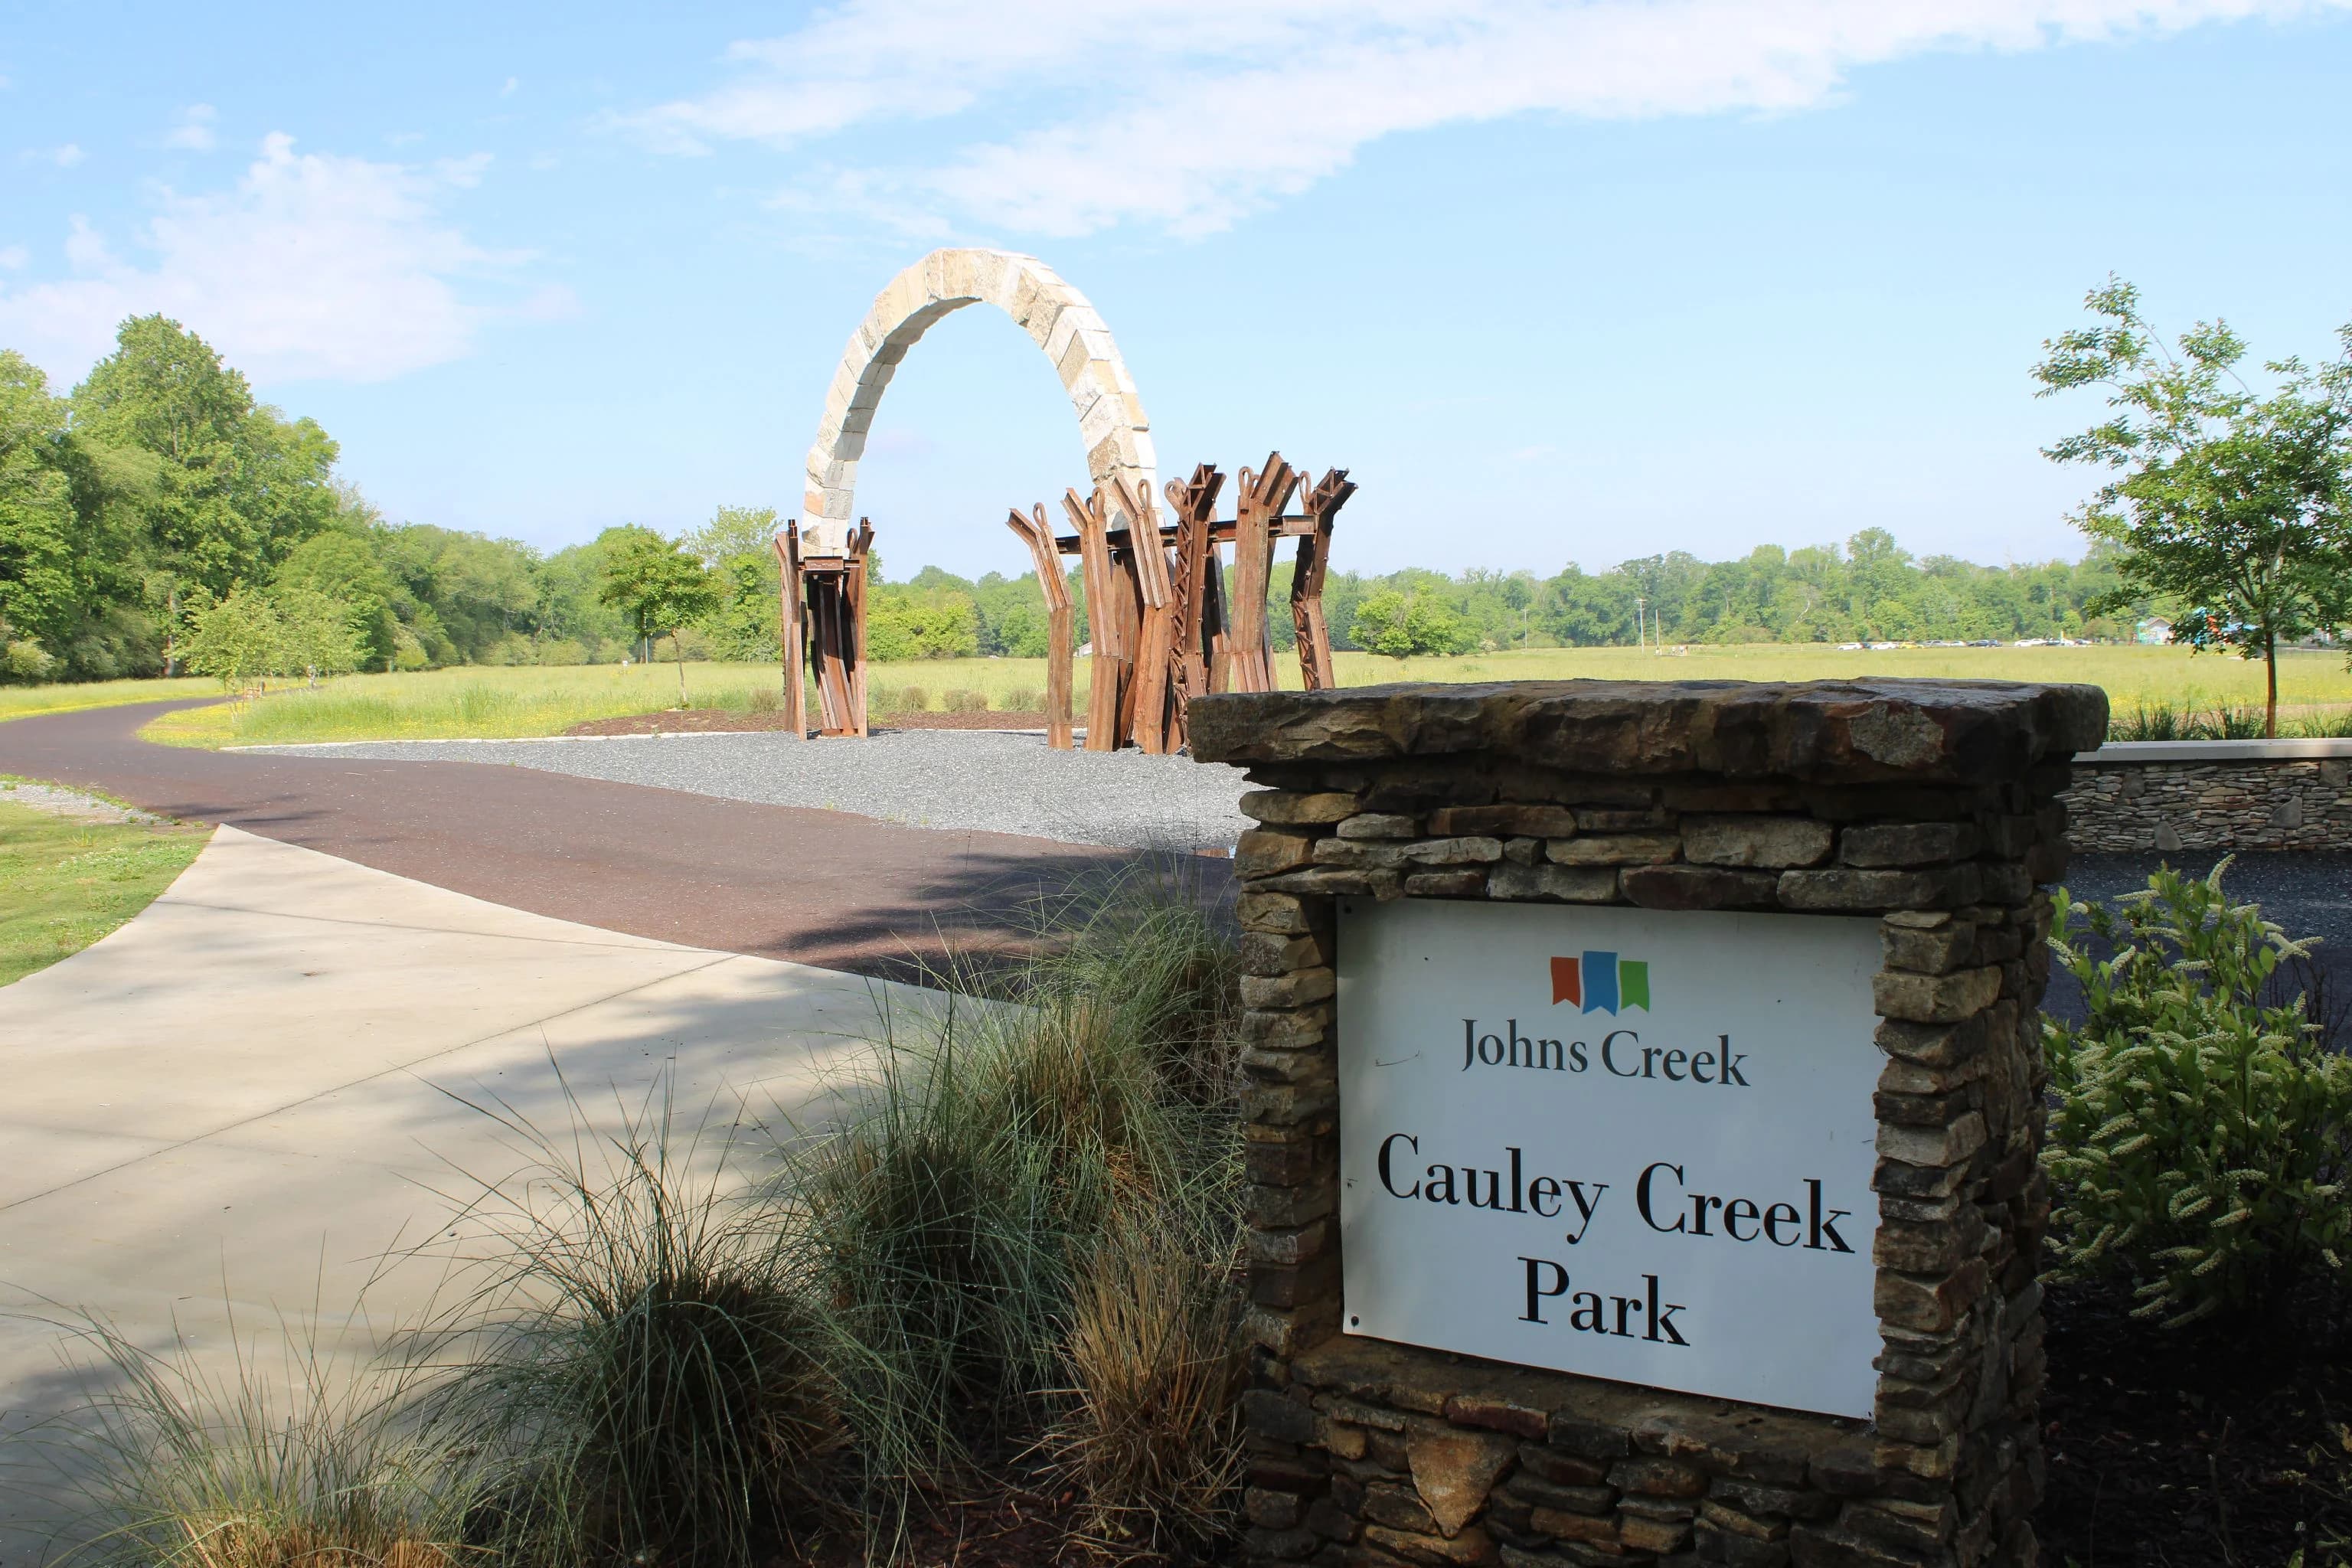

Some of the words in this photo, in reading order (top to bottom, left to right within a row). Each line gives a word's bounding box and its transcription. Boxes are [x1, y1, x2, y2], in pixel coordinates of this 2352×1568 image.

[1462, 1018, 1588, 1073] Johns
[1602, 1031, 1751, 1086] Creek
[1377, 1133, 1610, 1245] Cauley
[1636, 1162, 1856, 1254] Creek
[1517, 1256, 1690, 1347] Park
